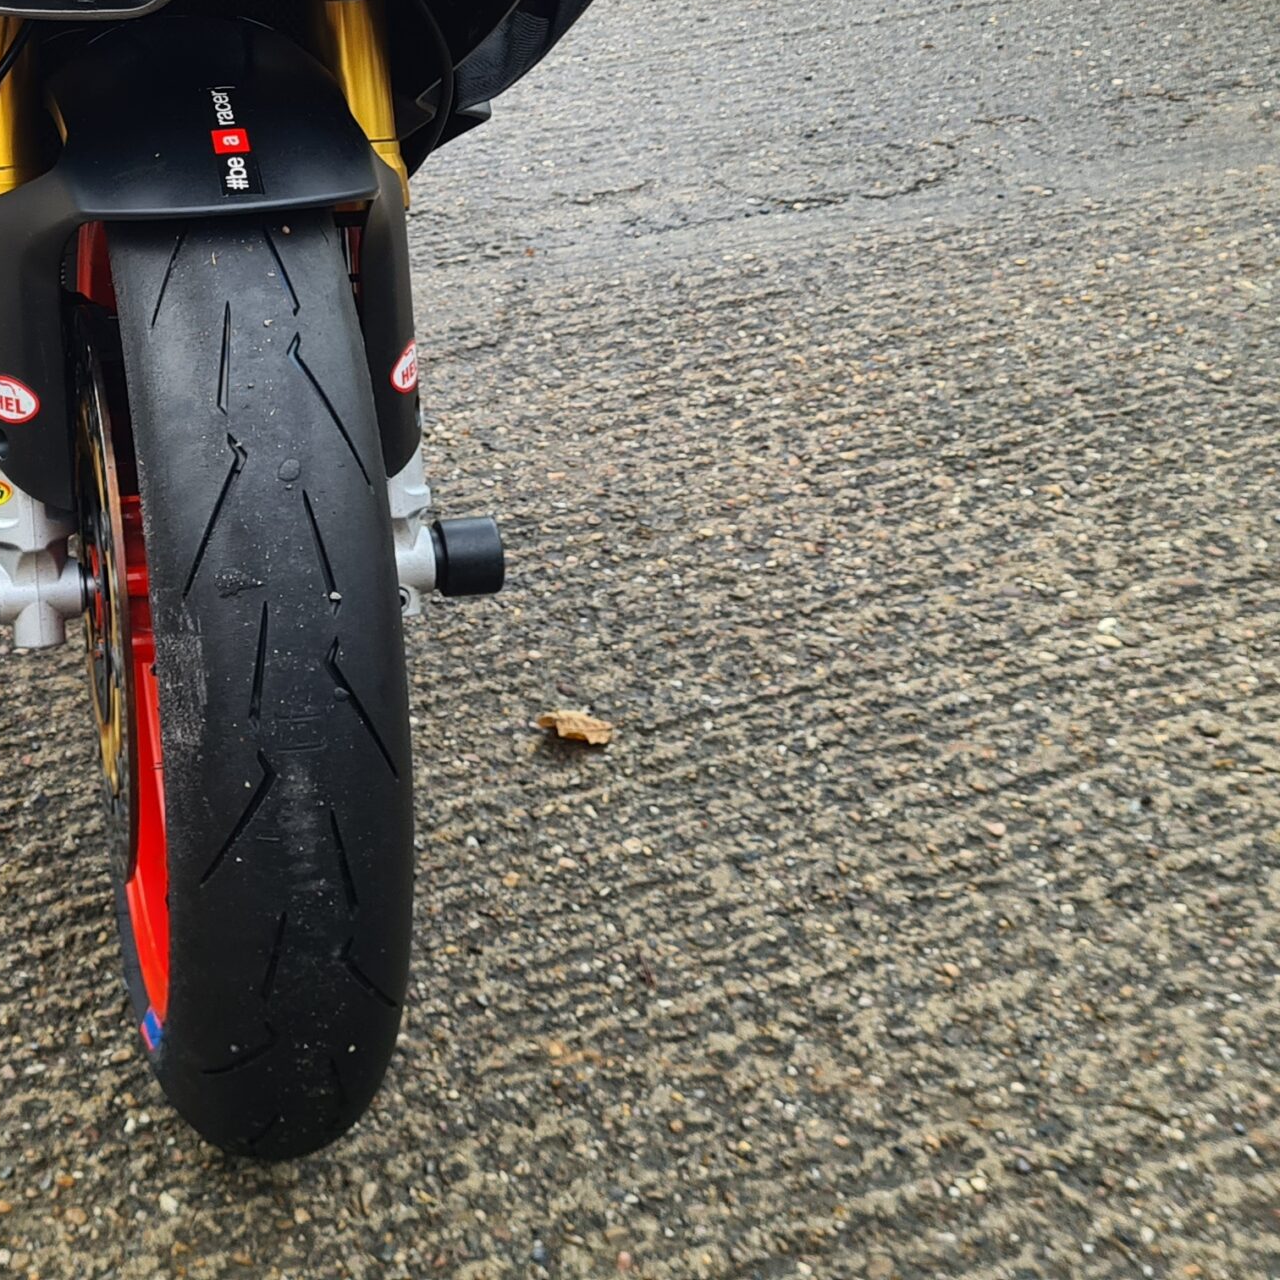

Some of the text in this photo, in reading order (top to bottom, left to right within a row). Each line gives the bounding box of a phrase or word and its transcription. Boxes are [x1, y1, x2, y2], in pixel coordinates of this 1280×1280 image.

[211, 90, 249, 190] #be a racer
[401, 360, 417, 386] HE
